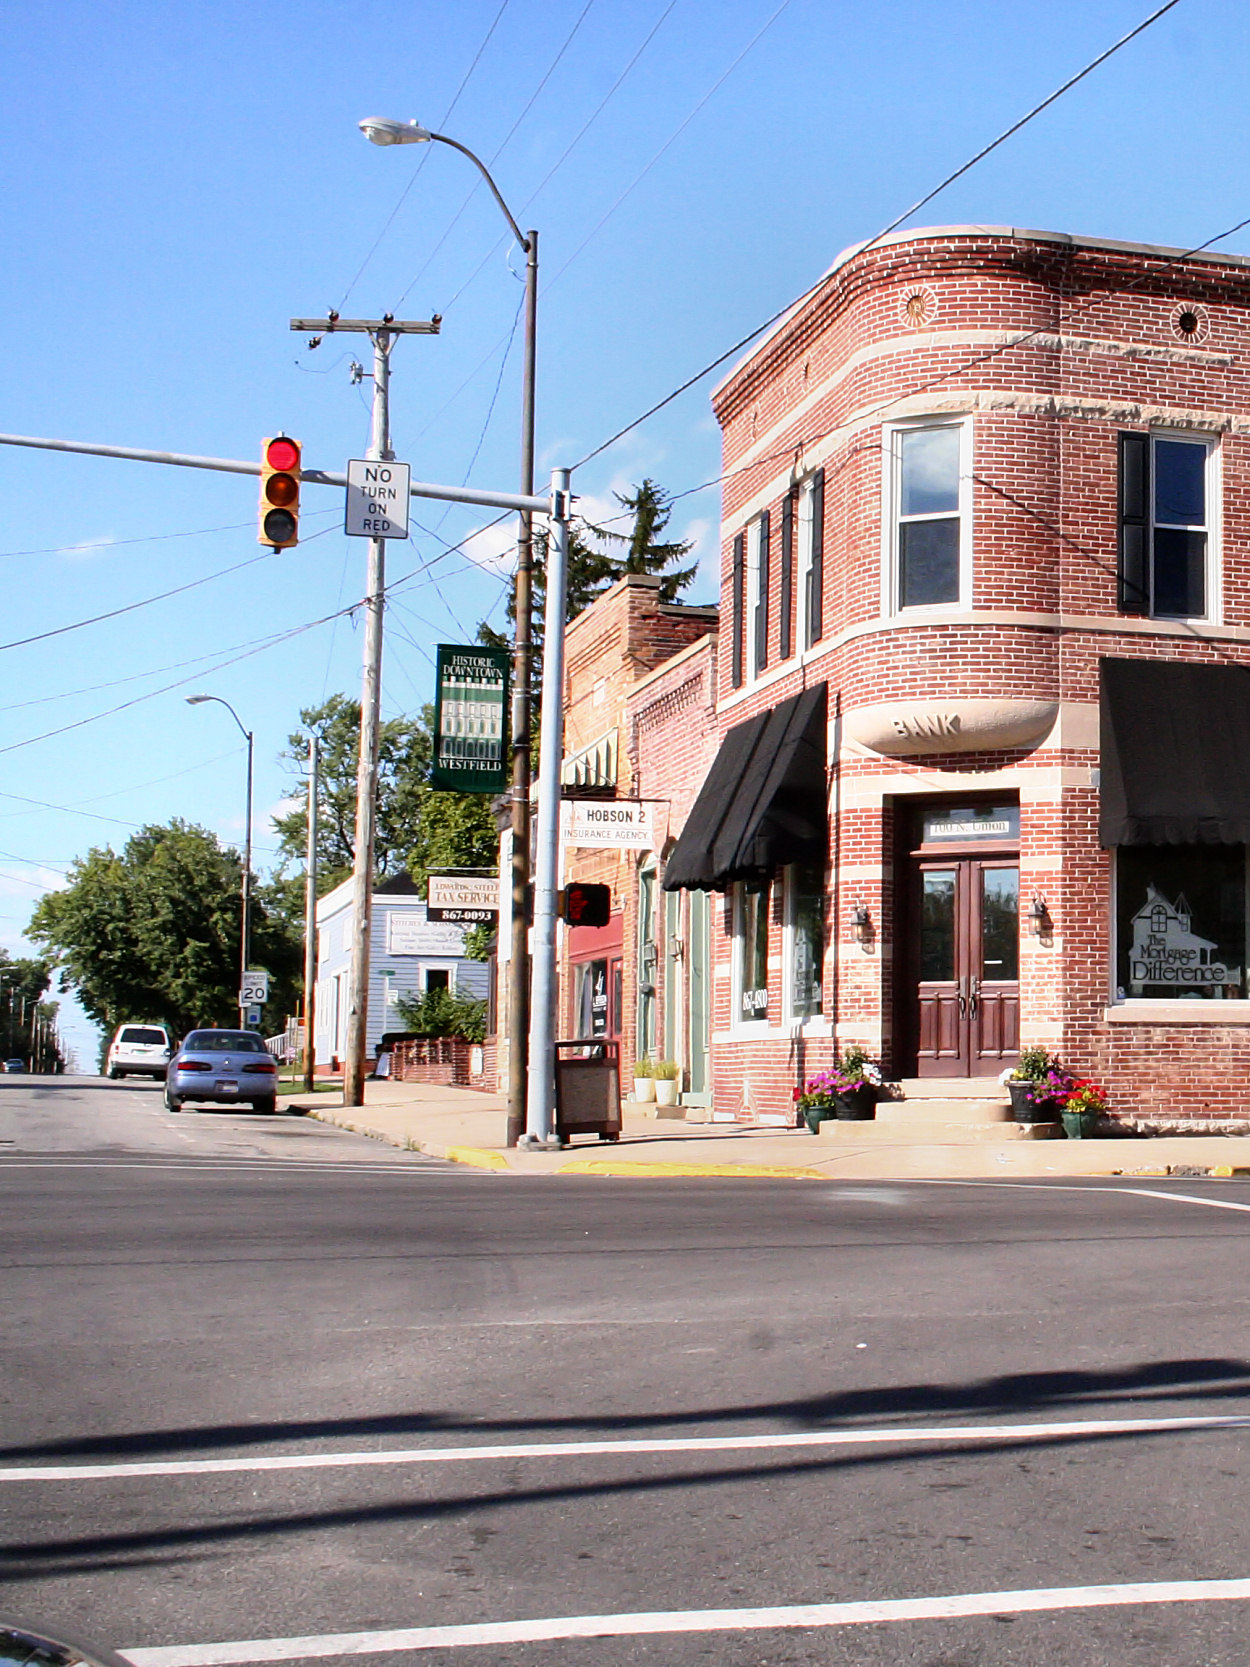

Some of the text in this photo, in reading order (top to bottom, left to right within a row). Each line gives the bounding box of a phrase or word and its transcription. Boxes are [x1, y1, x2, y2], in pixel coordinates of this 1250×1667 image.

[365, 467, 392, 483] NO
[361, 486, 396, 500] TURN
[368, 503, 387, 515] ON
[363, 518, 390, 531] RED
[452, 655, 495, 668] HISTORIC
[443, 664, 503, 678] DOWNTOWN
[893, 713, 961, 737] BANK
[438, 758, 502, 771] WESTFIELD
[587, 809, 633, 822] HOBSON
[564, 829, 648, 840] INSURANCE AGENCY
[435, 891, 499, 905] TAX SERVICE
[442, 910, 492, 921] 867-0093
[1148, 934, 1166, 945] The
[1140, 945, 1197, 965] Mortgage
[1132, 961, 1225, 981] Difference
[244, 987, 265, 999] 20
